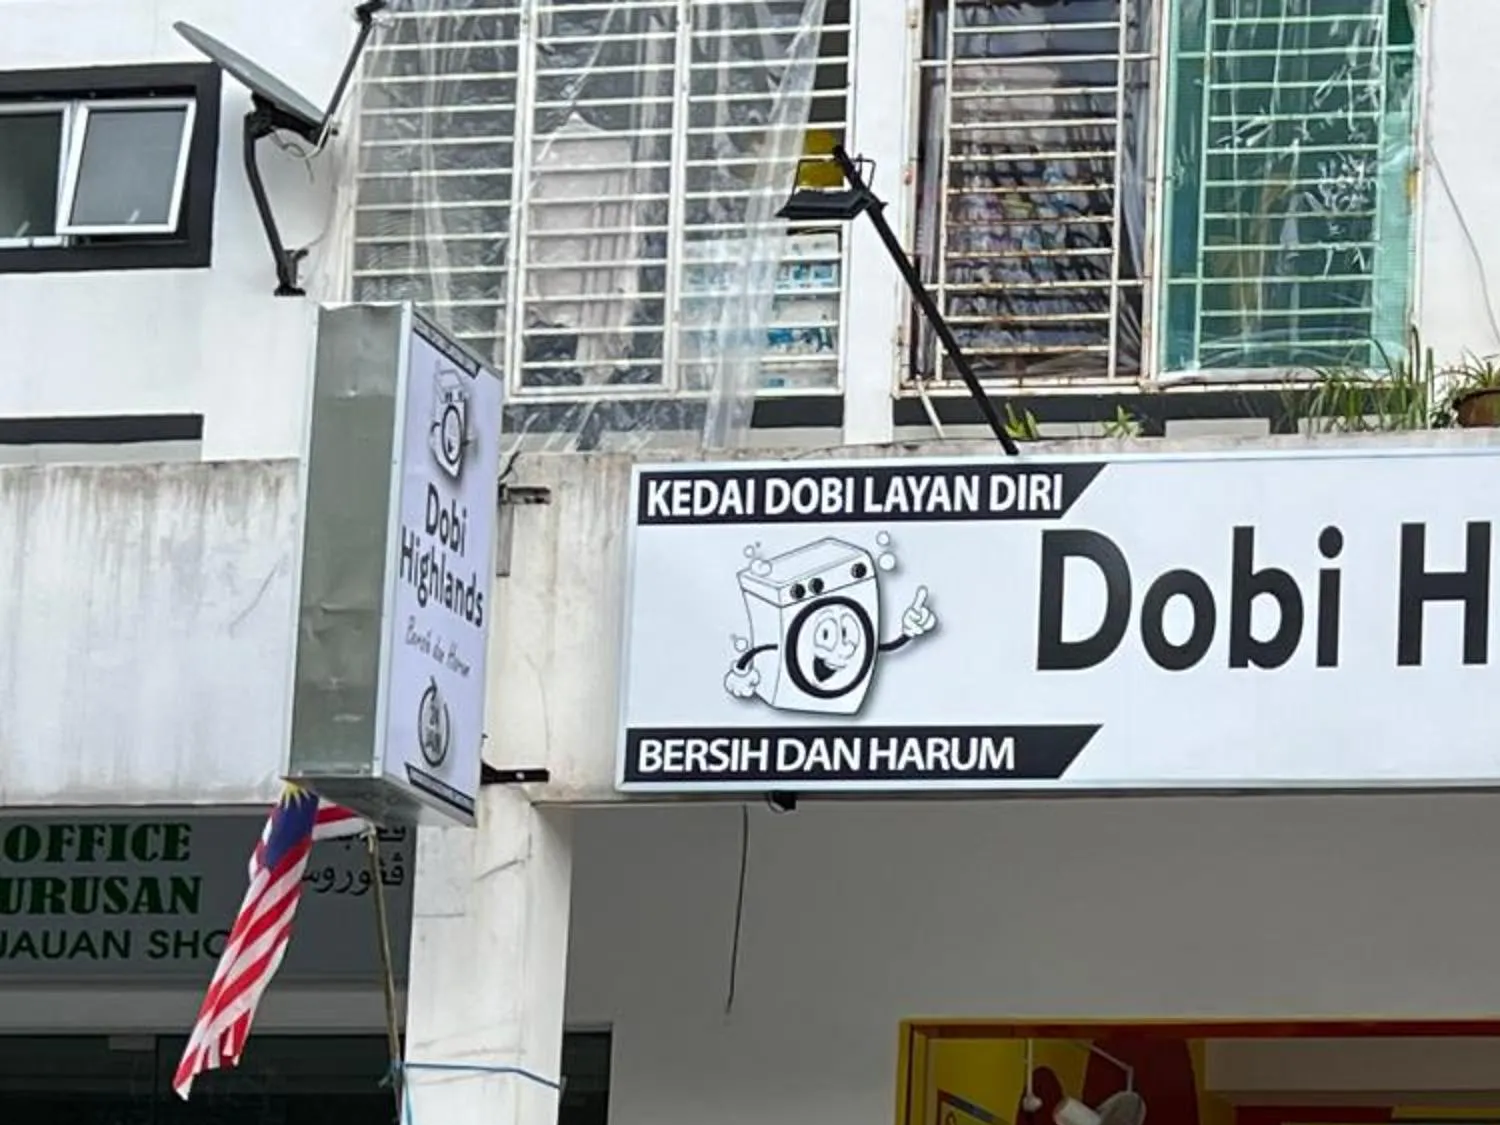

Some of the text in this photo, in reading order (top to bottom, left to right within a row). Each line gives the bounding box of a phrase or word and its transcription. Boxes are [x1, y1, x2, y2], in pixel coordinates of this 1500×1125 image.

[425, 484, 467, 558] Dobi
[646, 473, 1062, 516] KEDAI DOBI LAYAN DIRI
[399, 526, 483, 629] Highlands
[1037, 524, 1344, 670] Dobi
[638, 737, 1015, 772] BERSIH DAN HARUM
[4, 824, 191, 862] OFFICE
